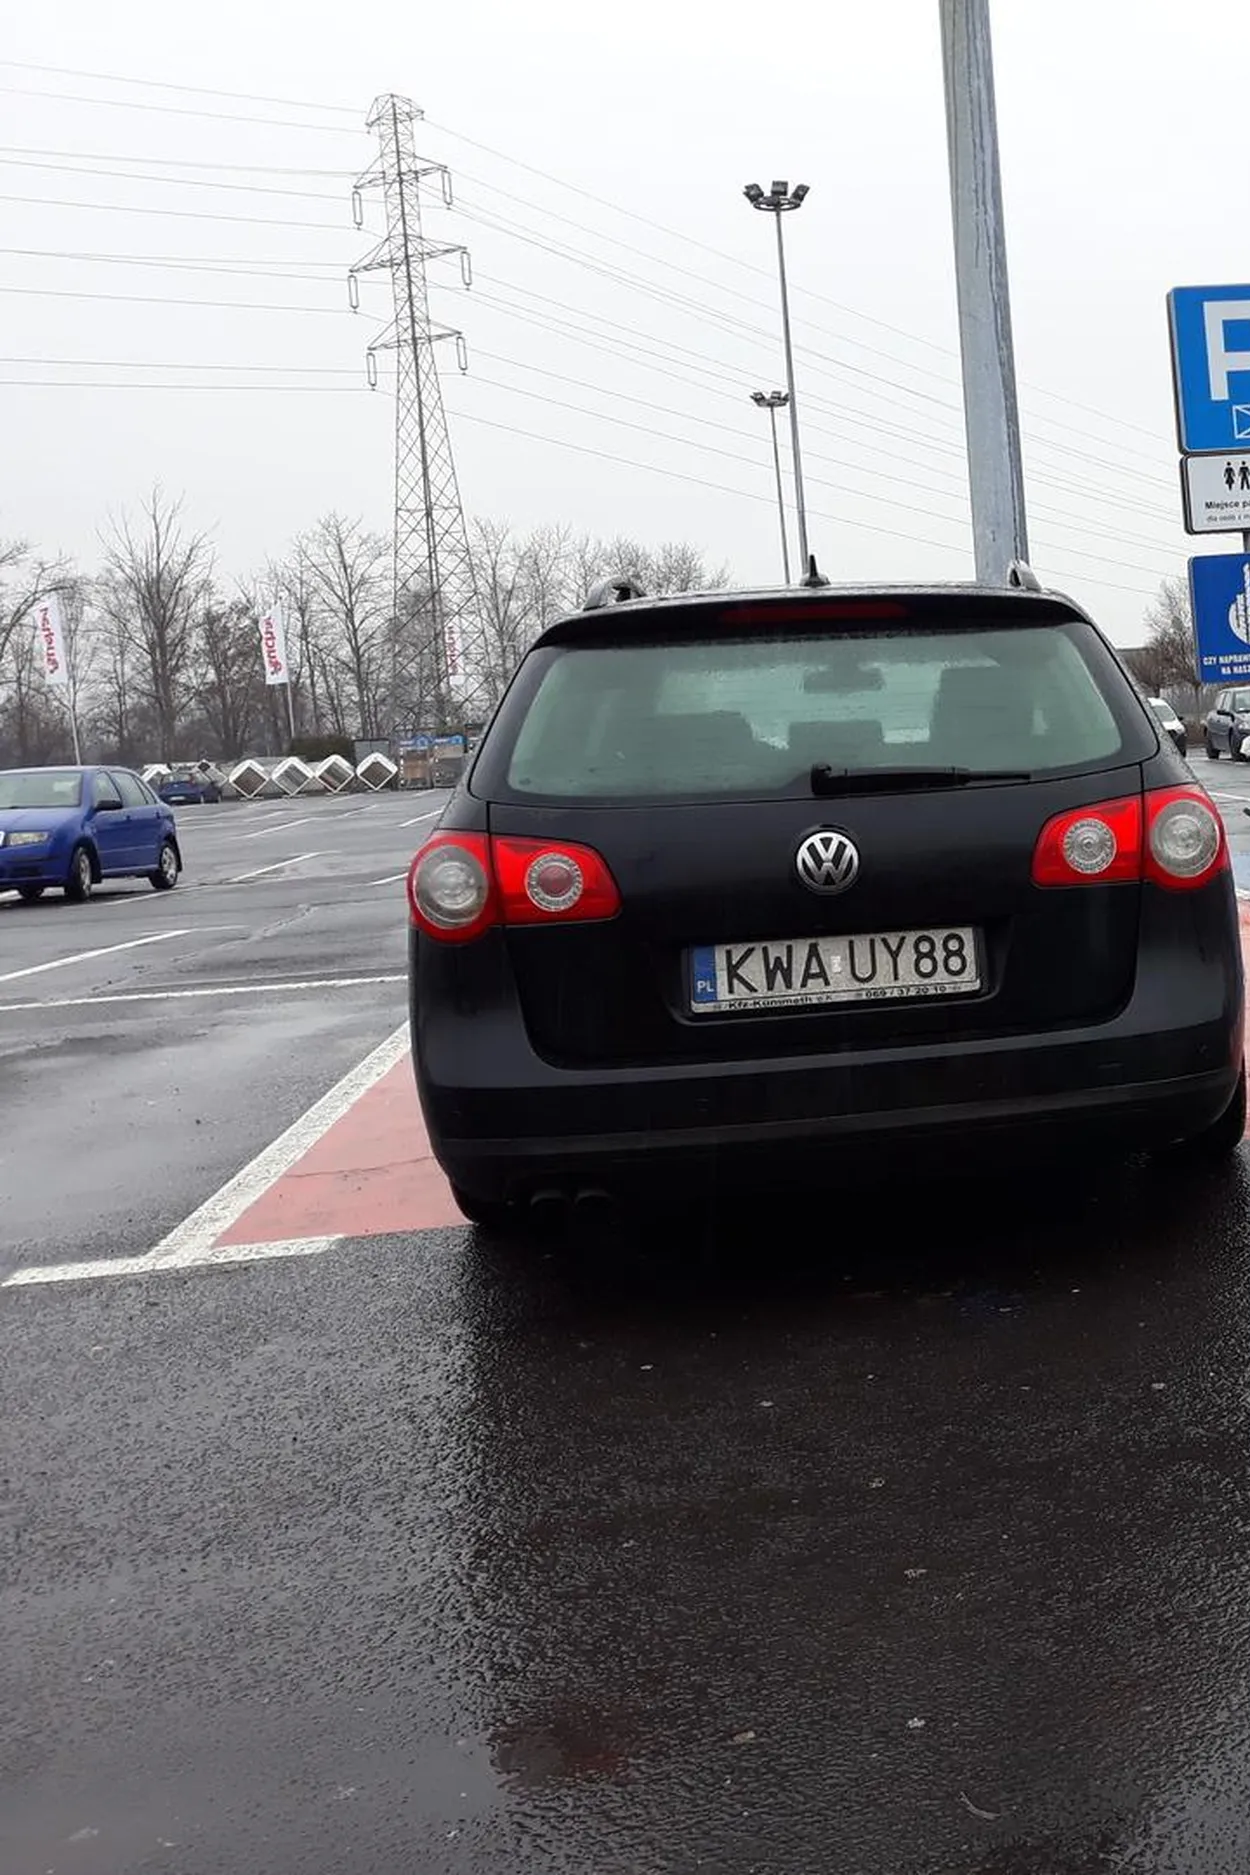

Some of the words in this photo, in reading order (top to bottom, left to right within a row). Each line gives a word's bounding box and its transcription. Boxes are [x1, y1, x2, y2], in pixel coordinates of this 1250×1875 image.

[1204, 501, 1240, 510] Miejsce
[1202, 656, 1217, 666] CZY
[1221, 666, 1232, 675] NA
[725, 942, 831, 995] KWA
[849, 933, 969, 984] UY88
[697, 980, 715, 993] PL
